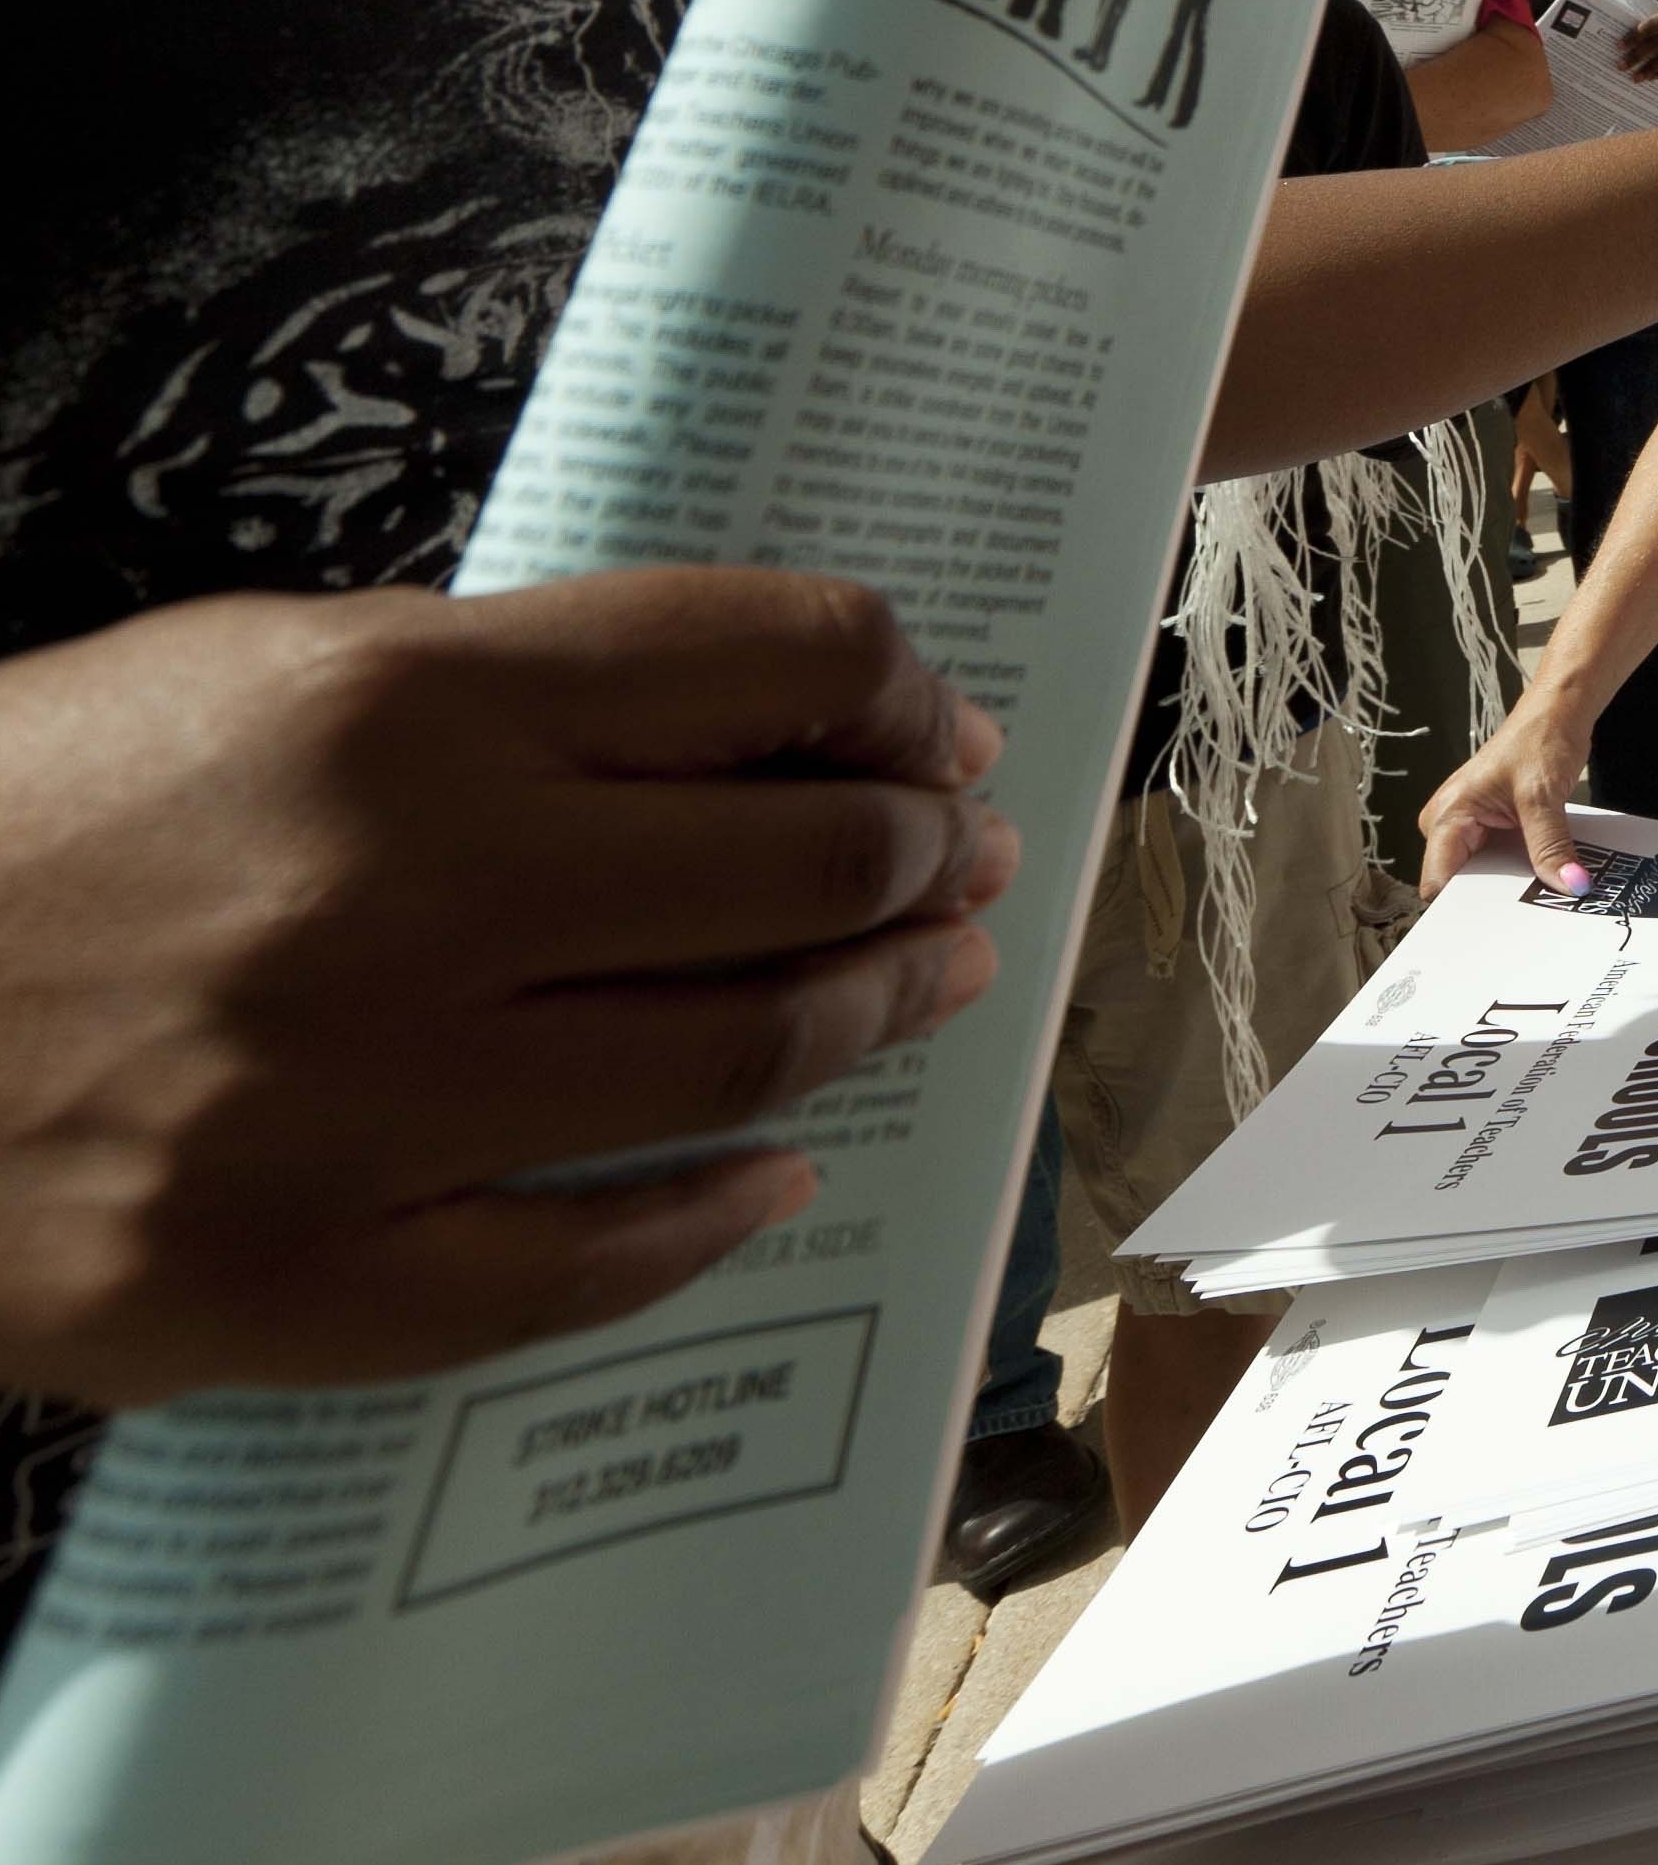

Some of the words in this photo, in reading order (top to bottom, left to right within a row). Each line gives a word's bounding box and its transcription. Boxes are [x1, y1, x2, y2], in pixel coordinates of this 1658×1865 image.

[1573, 959, 1641, 1020] American
[1356, 1031, 1440, 1104] AFL-CIO
[1405, 999, 1570, 1106] Local
[1510, 1020, 1597, 1096] Federation
[1373, 1117, 1467, 1141] 1
[1495, 1099, 1529, 1115] of
[1434, 1115, 1522, 1191] Teachers
[514, 1395, 634, 1466] STRIKE
[639, 1360, 794, 1426] HOTLINE
[1310, 1324, 1475, 1524] Local
[1245, 1401, 1353, 1532] AFL-CIO
[1269, 1536, 1388, 1595] 1
[1348, 1528, 1462, 1677] Teachers
